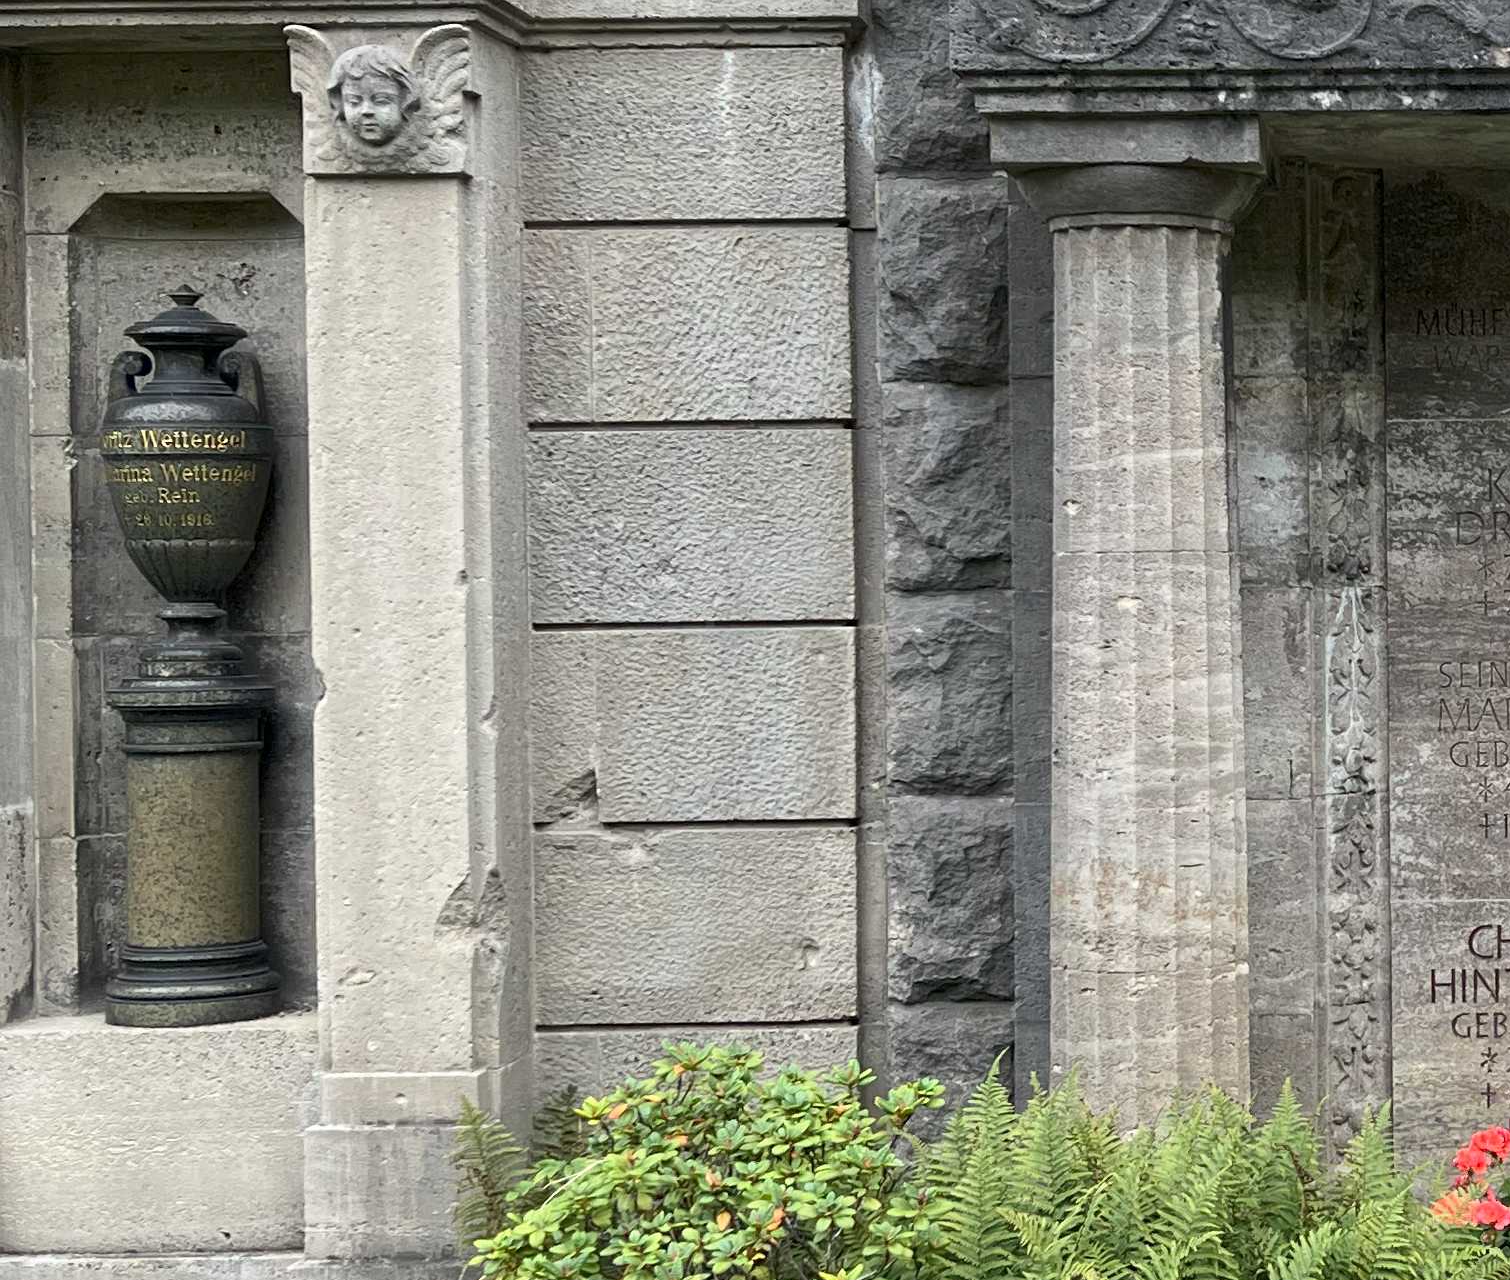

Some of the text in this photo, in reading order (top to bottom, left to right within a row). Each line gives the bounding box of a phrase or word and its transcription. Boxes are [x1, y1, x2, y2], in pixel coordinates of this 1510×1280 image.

[140, 428, 247, 453] Wettengel
[159, 463, 257, 485] Wettengel
[157, 486, 201, 504] Rein
[1449, 739, 1510, 768] GEB
[1451, 1011, 1508, 1039] GEB
